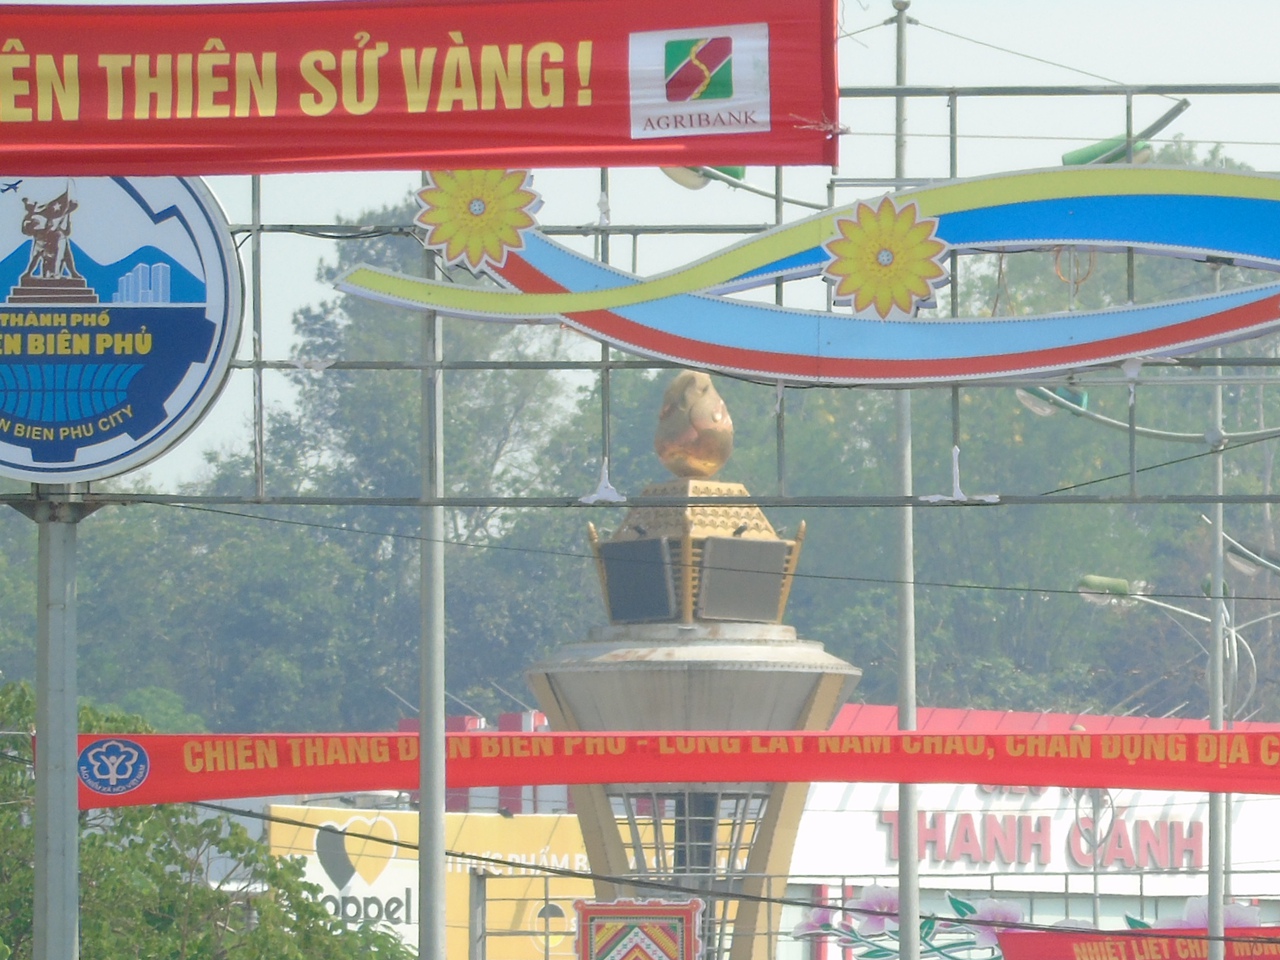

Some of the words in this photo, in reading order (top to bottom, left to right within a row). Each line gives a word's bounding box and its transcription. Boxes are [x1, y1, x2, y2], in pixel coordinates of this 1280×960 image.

[98, 37, 277, 120] THIÊN
[300, 31, 389, 117] SỬ
[642, 110, 757, 131] AGRIBANK
[70, 309, 110, 327] PHỐ
[27, 329, 90, 355] BIÊN
[96, 325, 152, 355] PHỦ
[14, 423, 55, 441] BIEN
[59, 424, 94, 441] PHU
[98, 405, 134, 432] CITY
[320, 887, 412, 926] oppel
